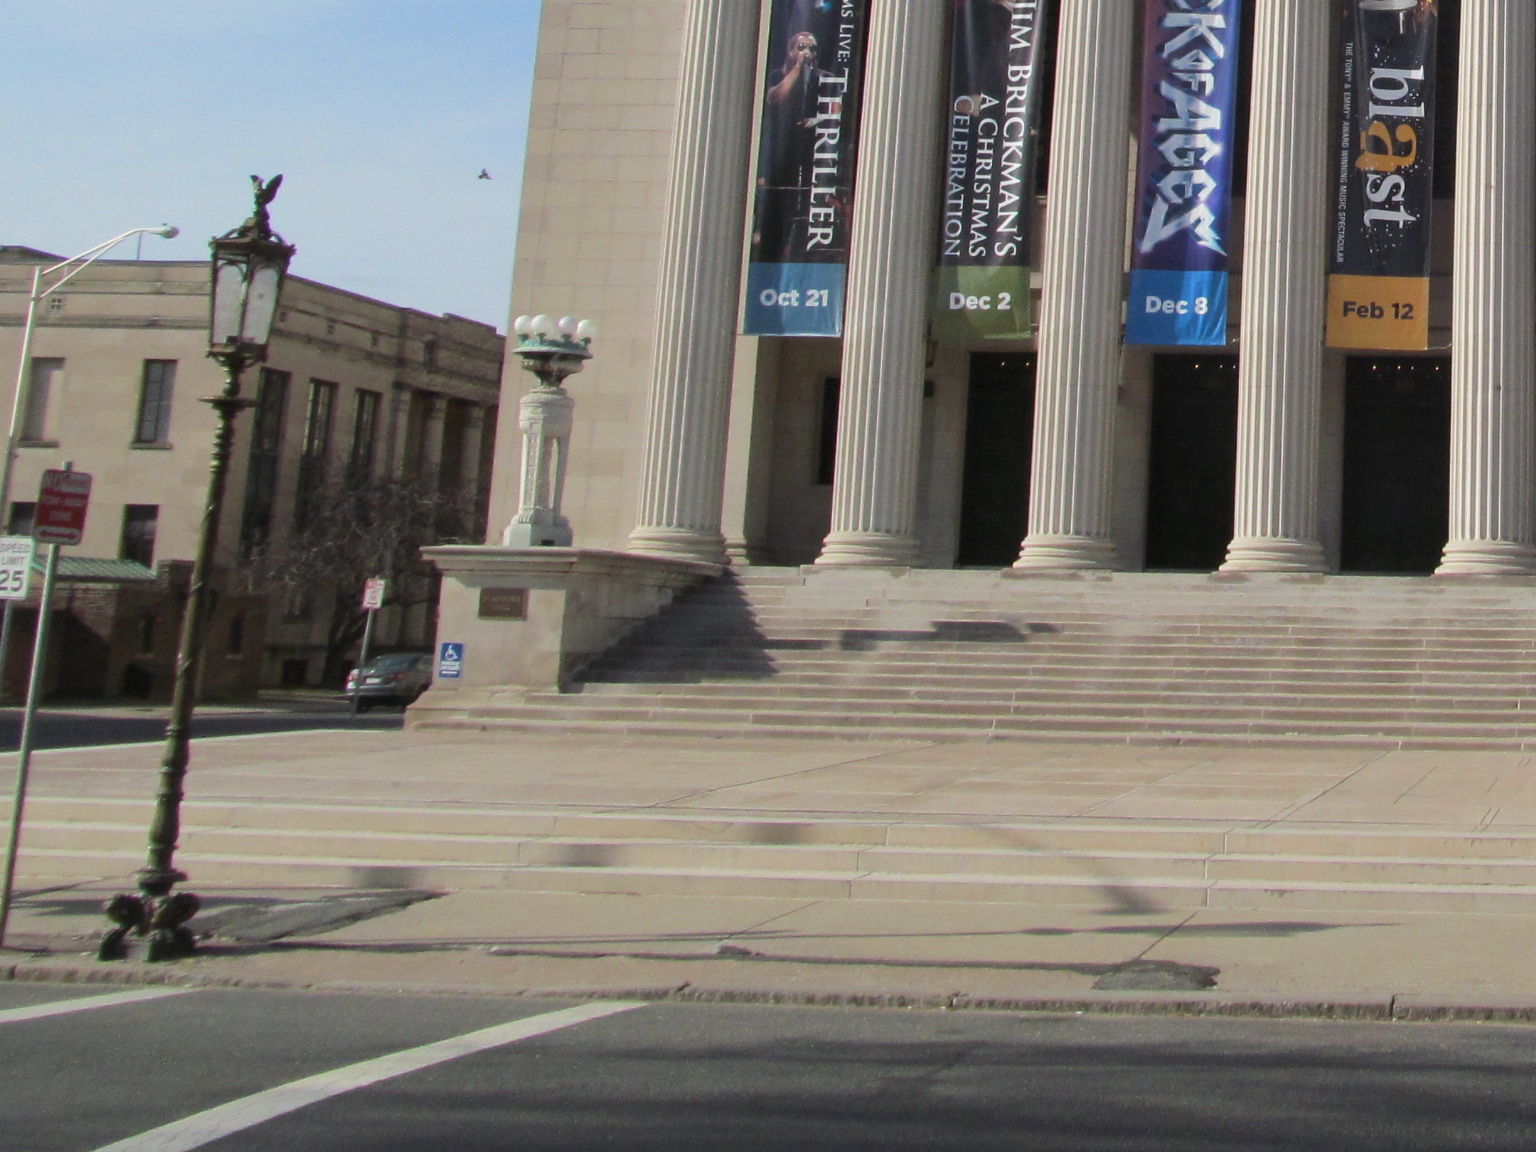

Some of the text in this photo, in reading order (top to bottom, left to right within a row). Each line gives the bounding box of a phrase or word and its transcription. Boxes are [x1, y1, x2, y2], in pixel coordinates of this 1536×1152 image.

[837, 24, 855, 62] LIVE:
[1345, 42, 1353, 56] THE
[994, 0, 1037, 256] JIM BRICKMAN'S
[1341, 121, 1350, 148] AWARD
[806, 67, 848, 252] THRILLER
[1355, 65, 1425, 229] blast
[944, 95, 975, 257] CELEBRATION
[968, 91, 1000, 257] A CHRISTMAS
[1140, 80, 1228, 256] AGES
[1340, 150, 1349, 183] WINNING
[1339, 186, 1348, 210] MUSIC
[1336, 212, 1346, 263] SPECTACULAR
[760, 289, 828, 307] Oct 21
[950, 292, 1011, 310] Dec 2
[1145, 296, 1208, 315] Dec 8
[1343, 302, 1414, 320] Feb 12
[0, 569, 24, 592] 25
